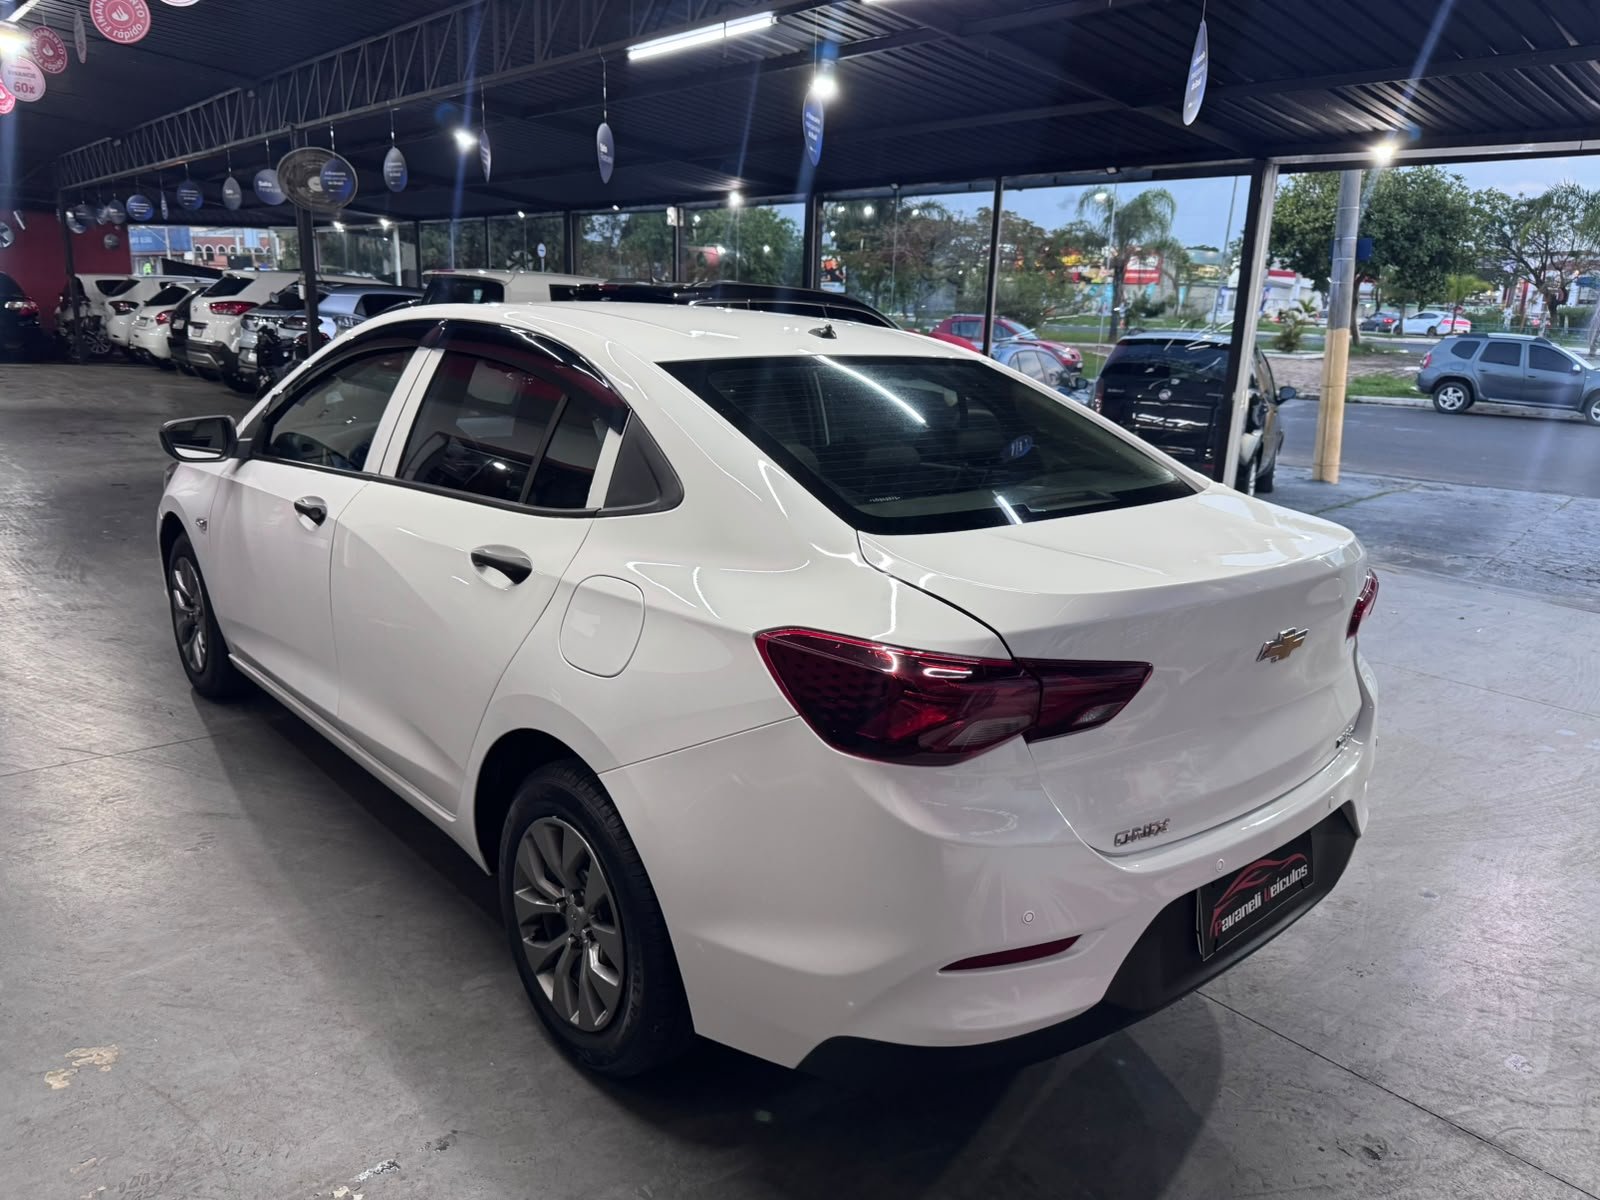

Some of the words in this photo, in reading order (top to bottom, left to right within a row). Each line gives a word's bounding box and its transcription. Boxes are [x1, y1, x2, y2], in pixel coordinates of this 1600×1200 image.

[112, 23, 143, 40] rápido
[14, 81, 36, 94] 60x
[1114, 818, 1170, 847] ONIX
[1214, 892, 1262, 936] Pavaneli
